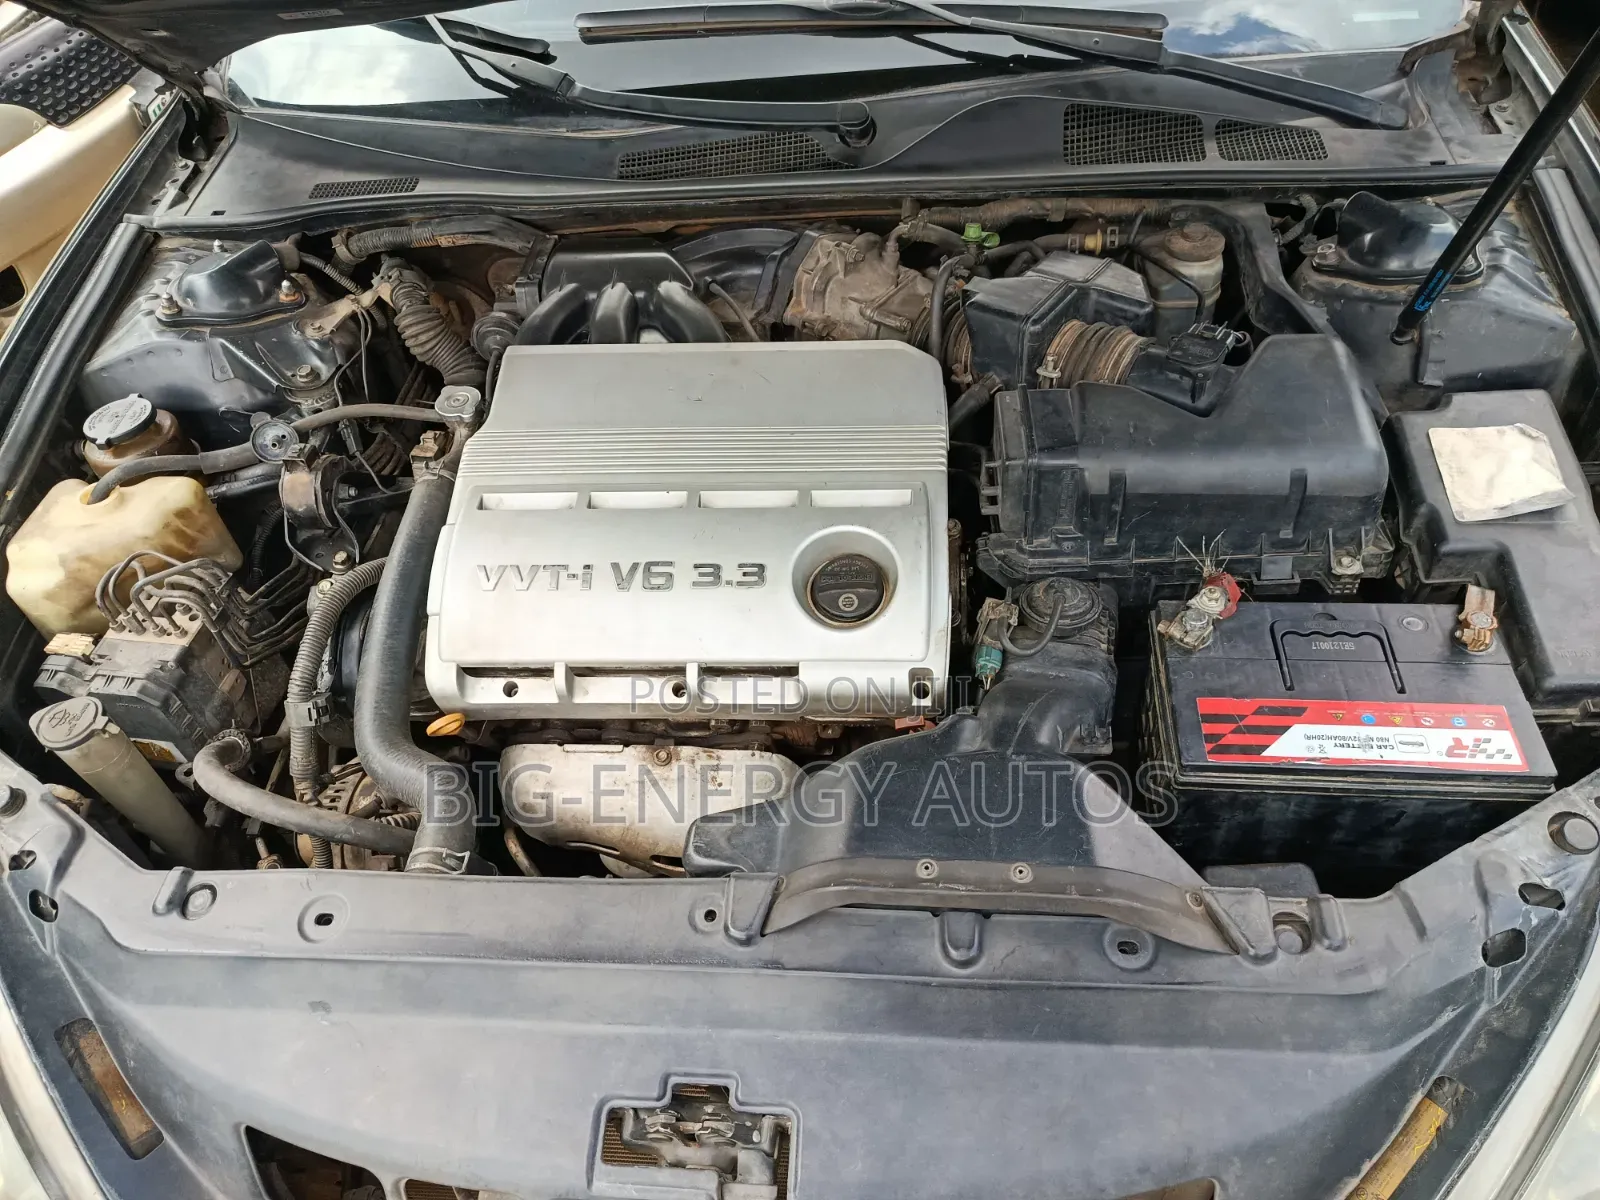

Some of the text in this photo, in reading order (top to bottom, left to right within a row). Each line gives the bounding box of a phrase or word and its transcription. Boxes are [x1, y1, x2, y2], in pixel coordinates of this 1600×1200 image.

[477, 561, 768, 592] VVT-i V6 3.3
[1311, 641, 1355, 650] 5E1210017
